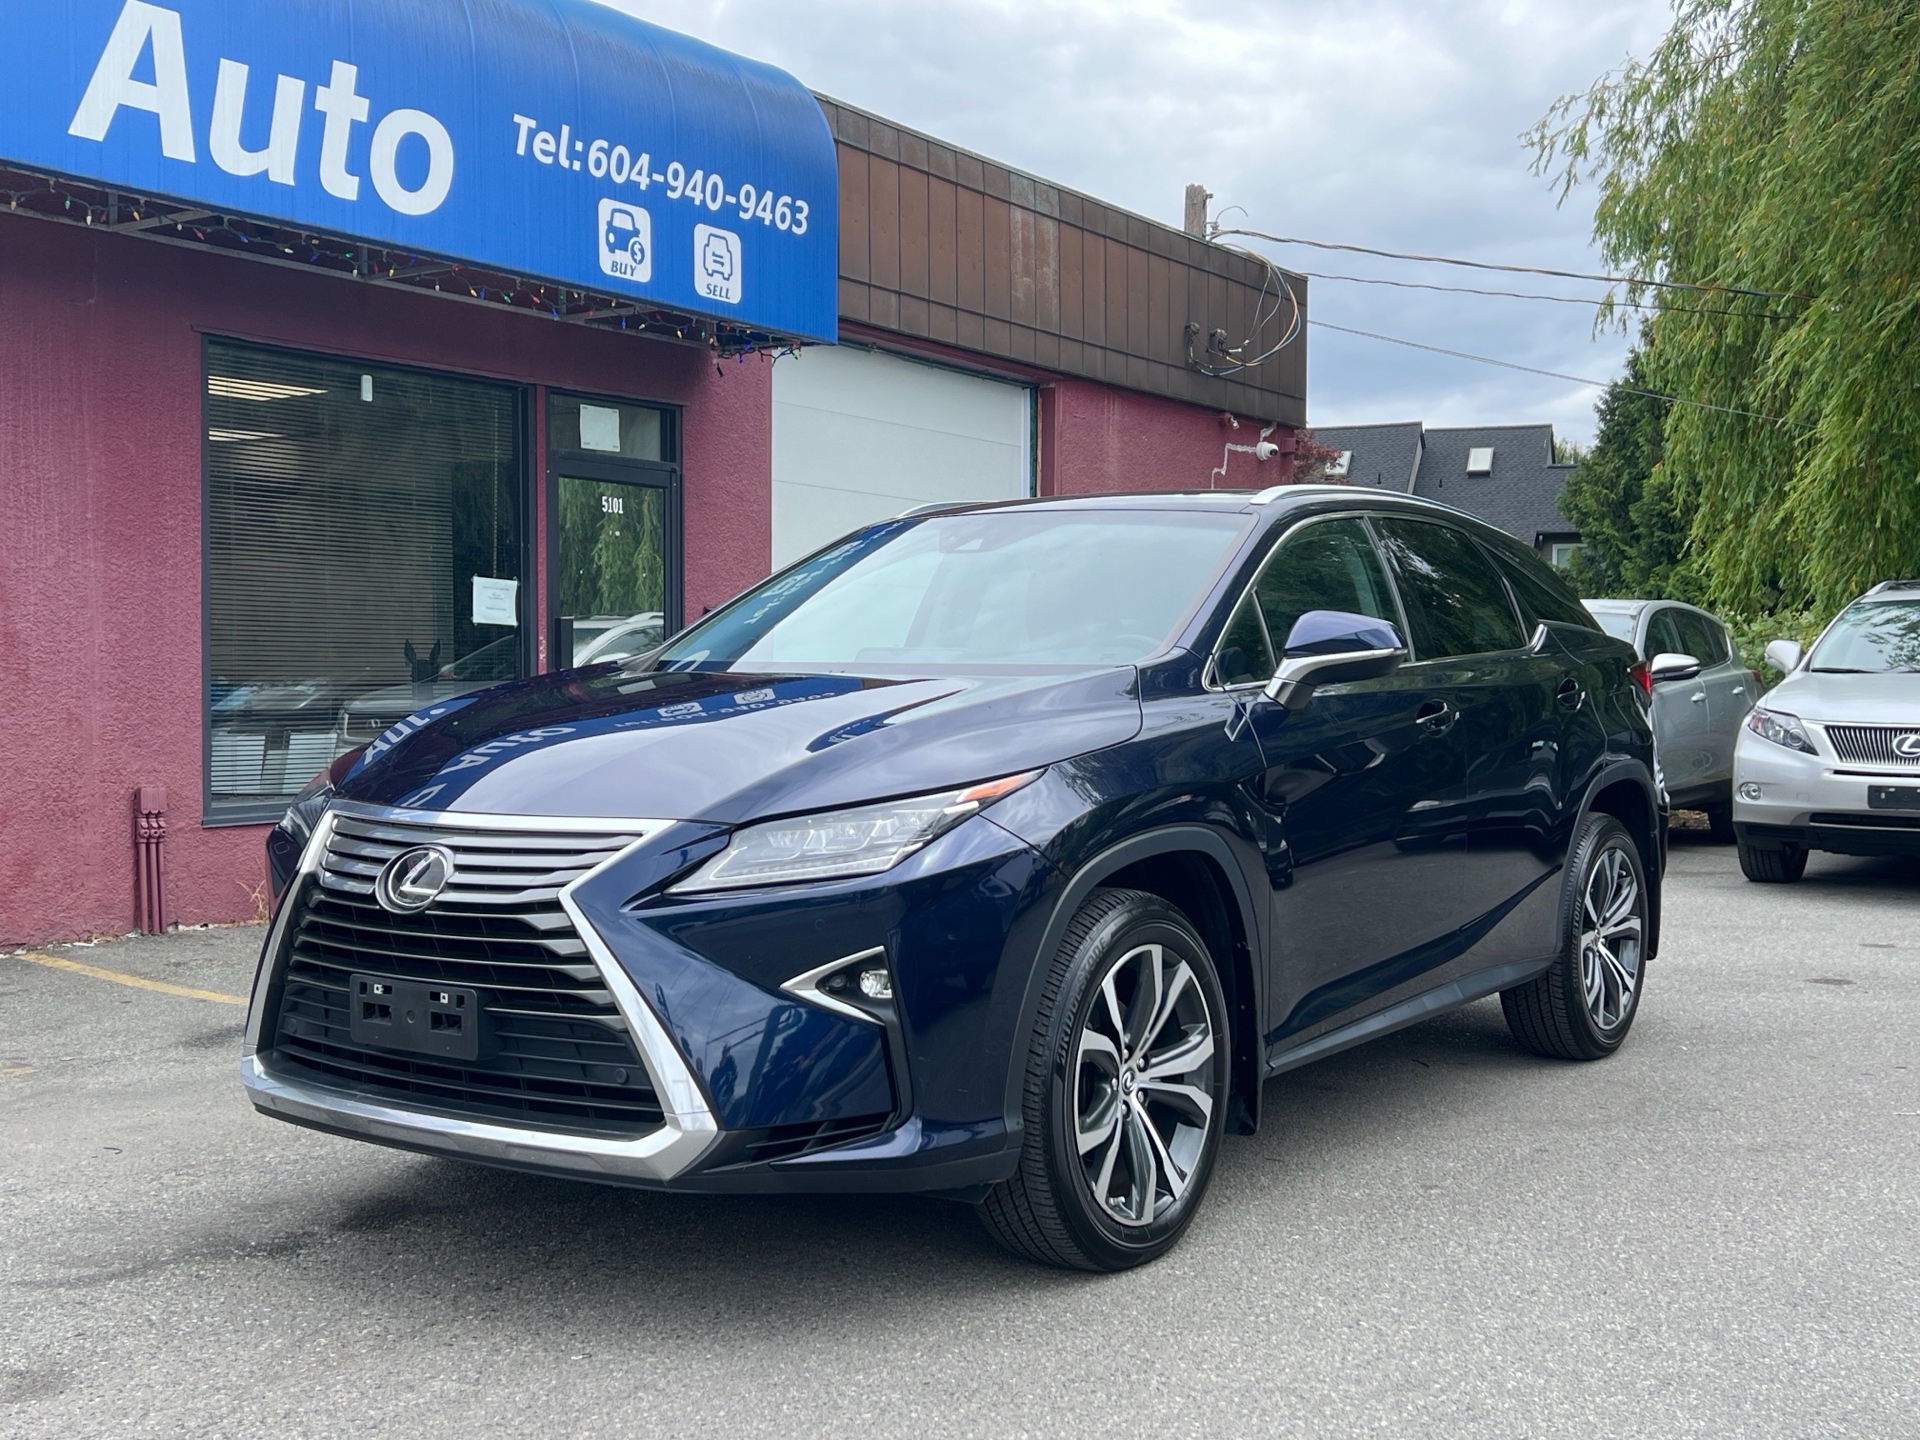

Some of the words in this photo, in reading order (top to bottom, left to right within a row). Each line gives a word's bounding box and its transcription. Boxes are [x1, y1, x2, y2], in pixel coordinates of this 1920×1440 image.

[68, 0, 455, 217] Auto
[610, 260, 637, 278] BUY
[705, 283, 731, 300] SELL
[601, 495, 624, 514] 5101
[1056, 937, 1107, 1067] BRIDGESTONE
